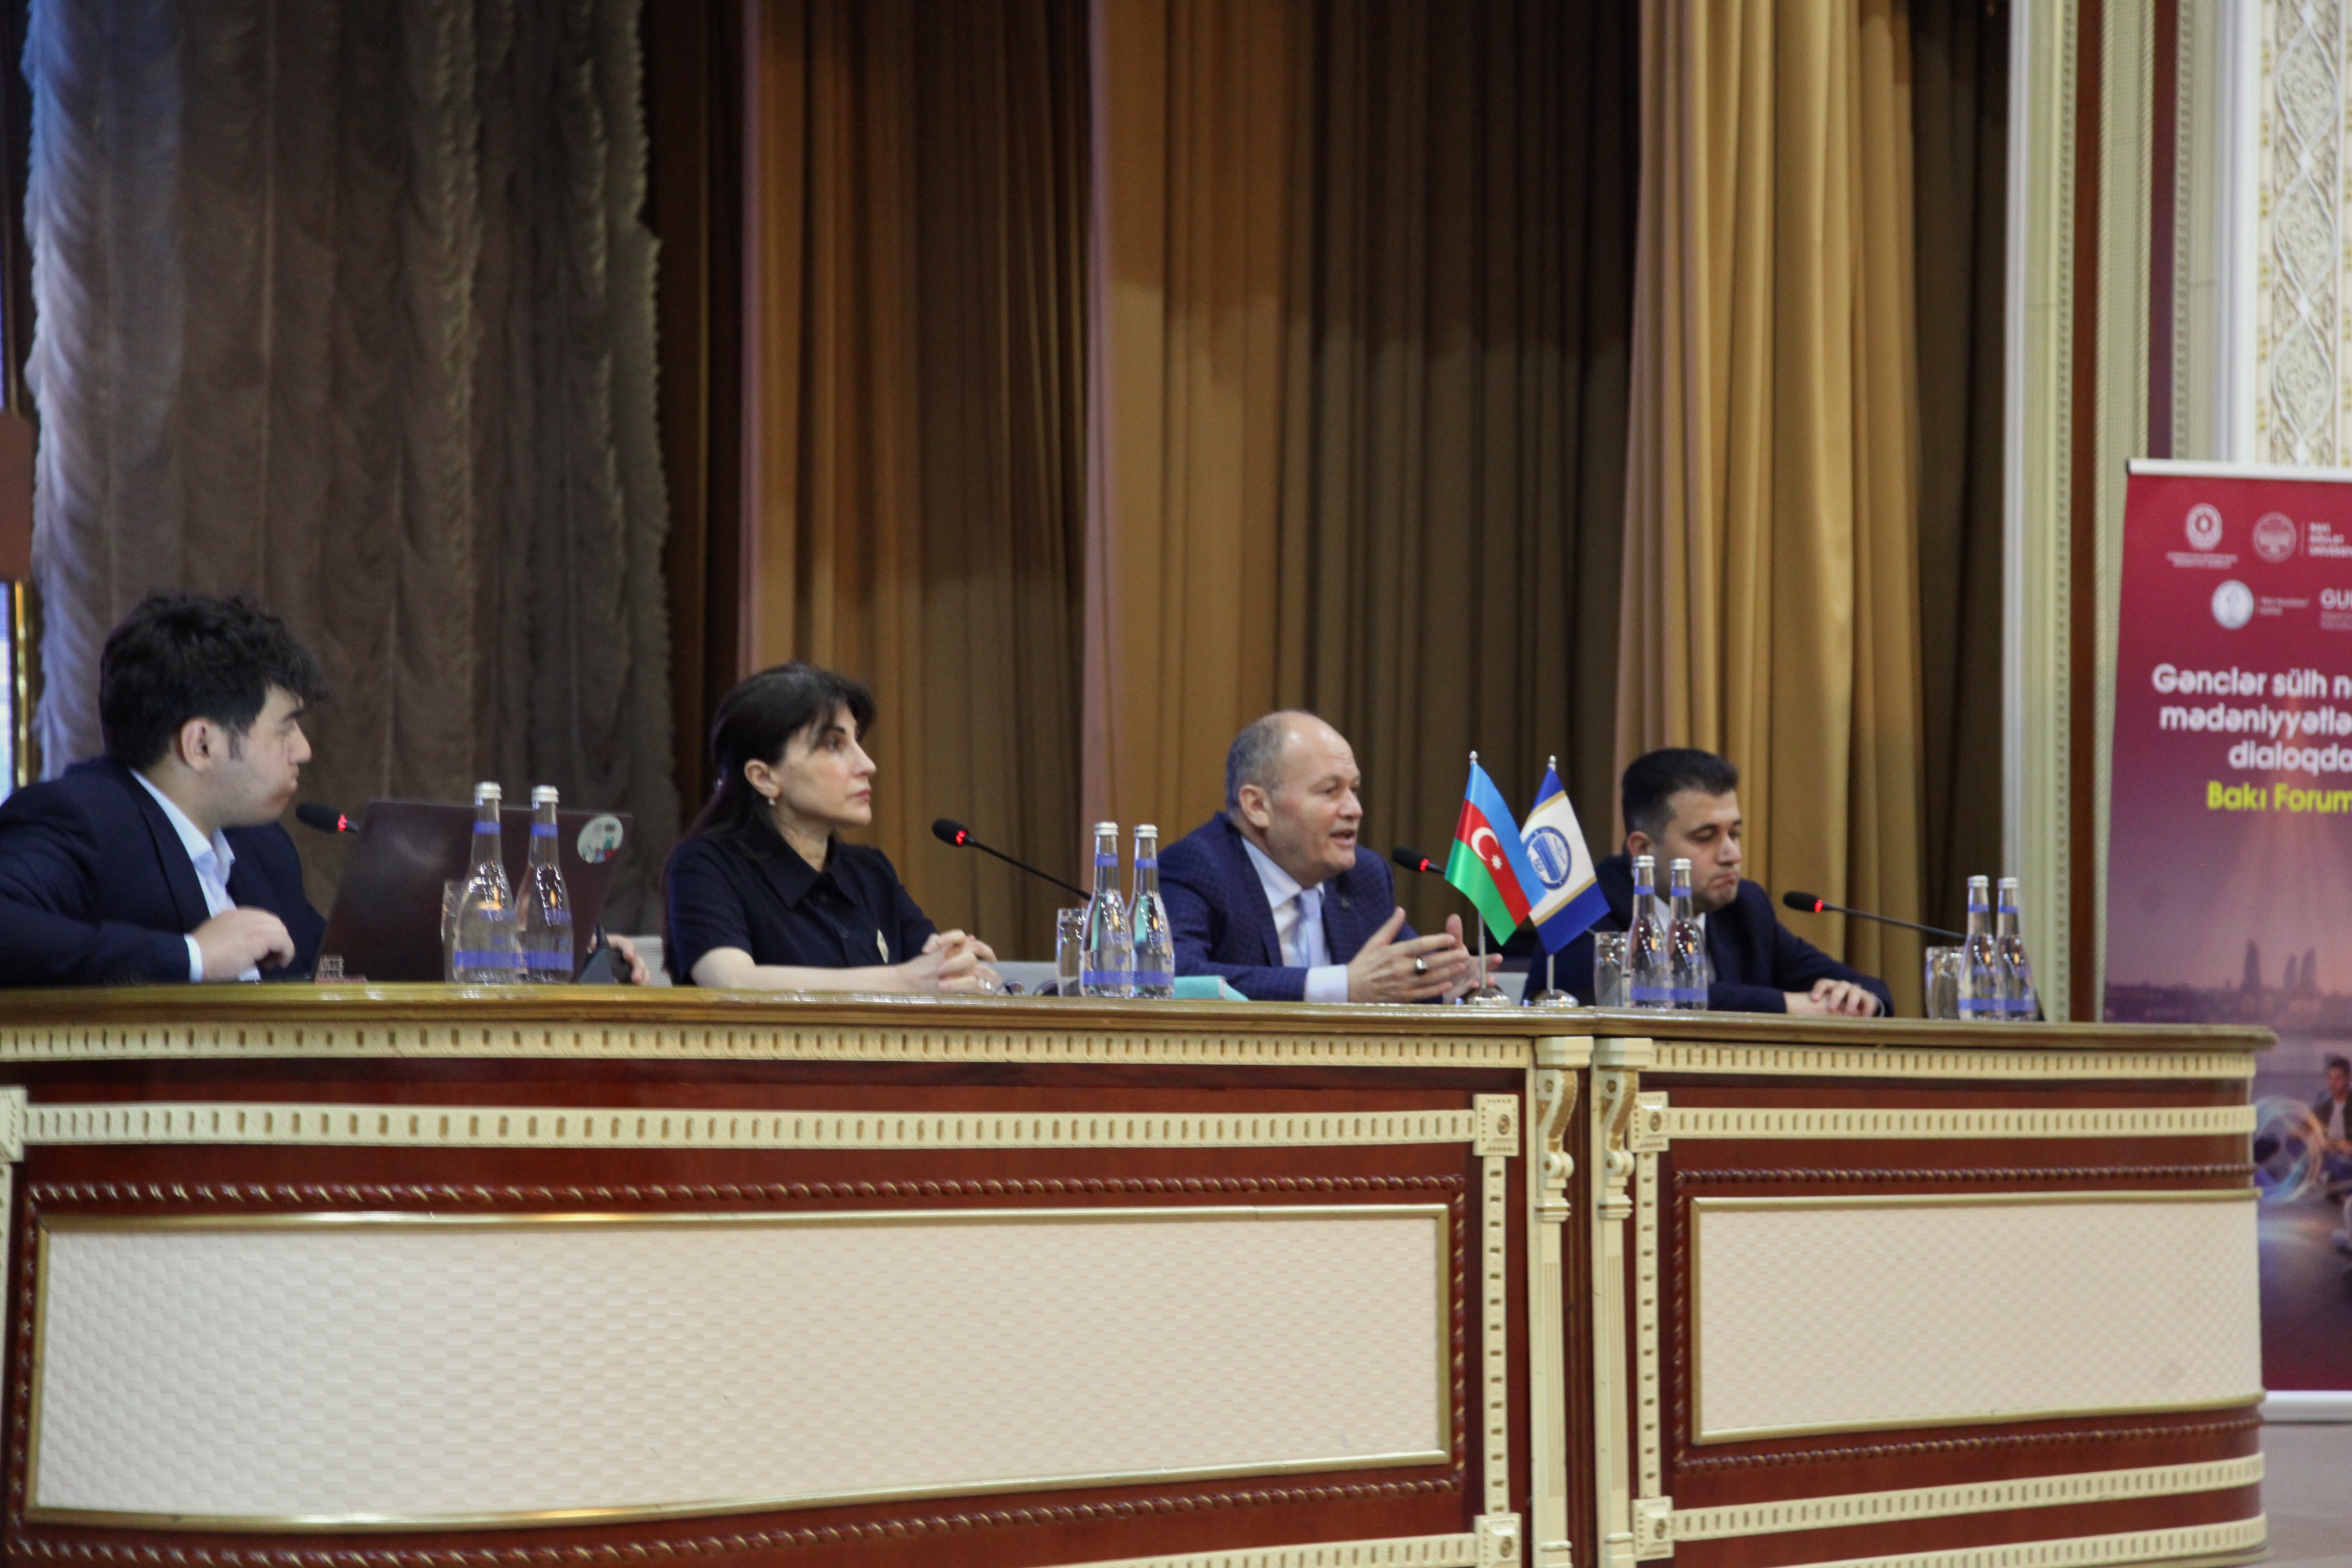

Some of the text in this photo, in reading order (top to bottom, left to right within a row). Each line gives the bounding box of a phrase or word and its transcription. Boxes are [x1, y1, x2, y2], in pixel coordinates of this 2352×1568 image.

[2321, 588, 2352, 609] GU
[2153, 663, 2267, 696] Gənclər
[2272, 669, 2327, 698] sülh
[2207, 781, 2267, 809] Bakı
